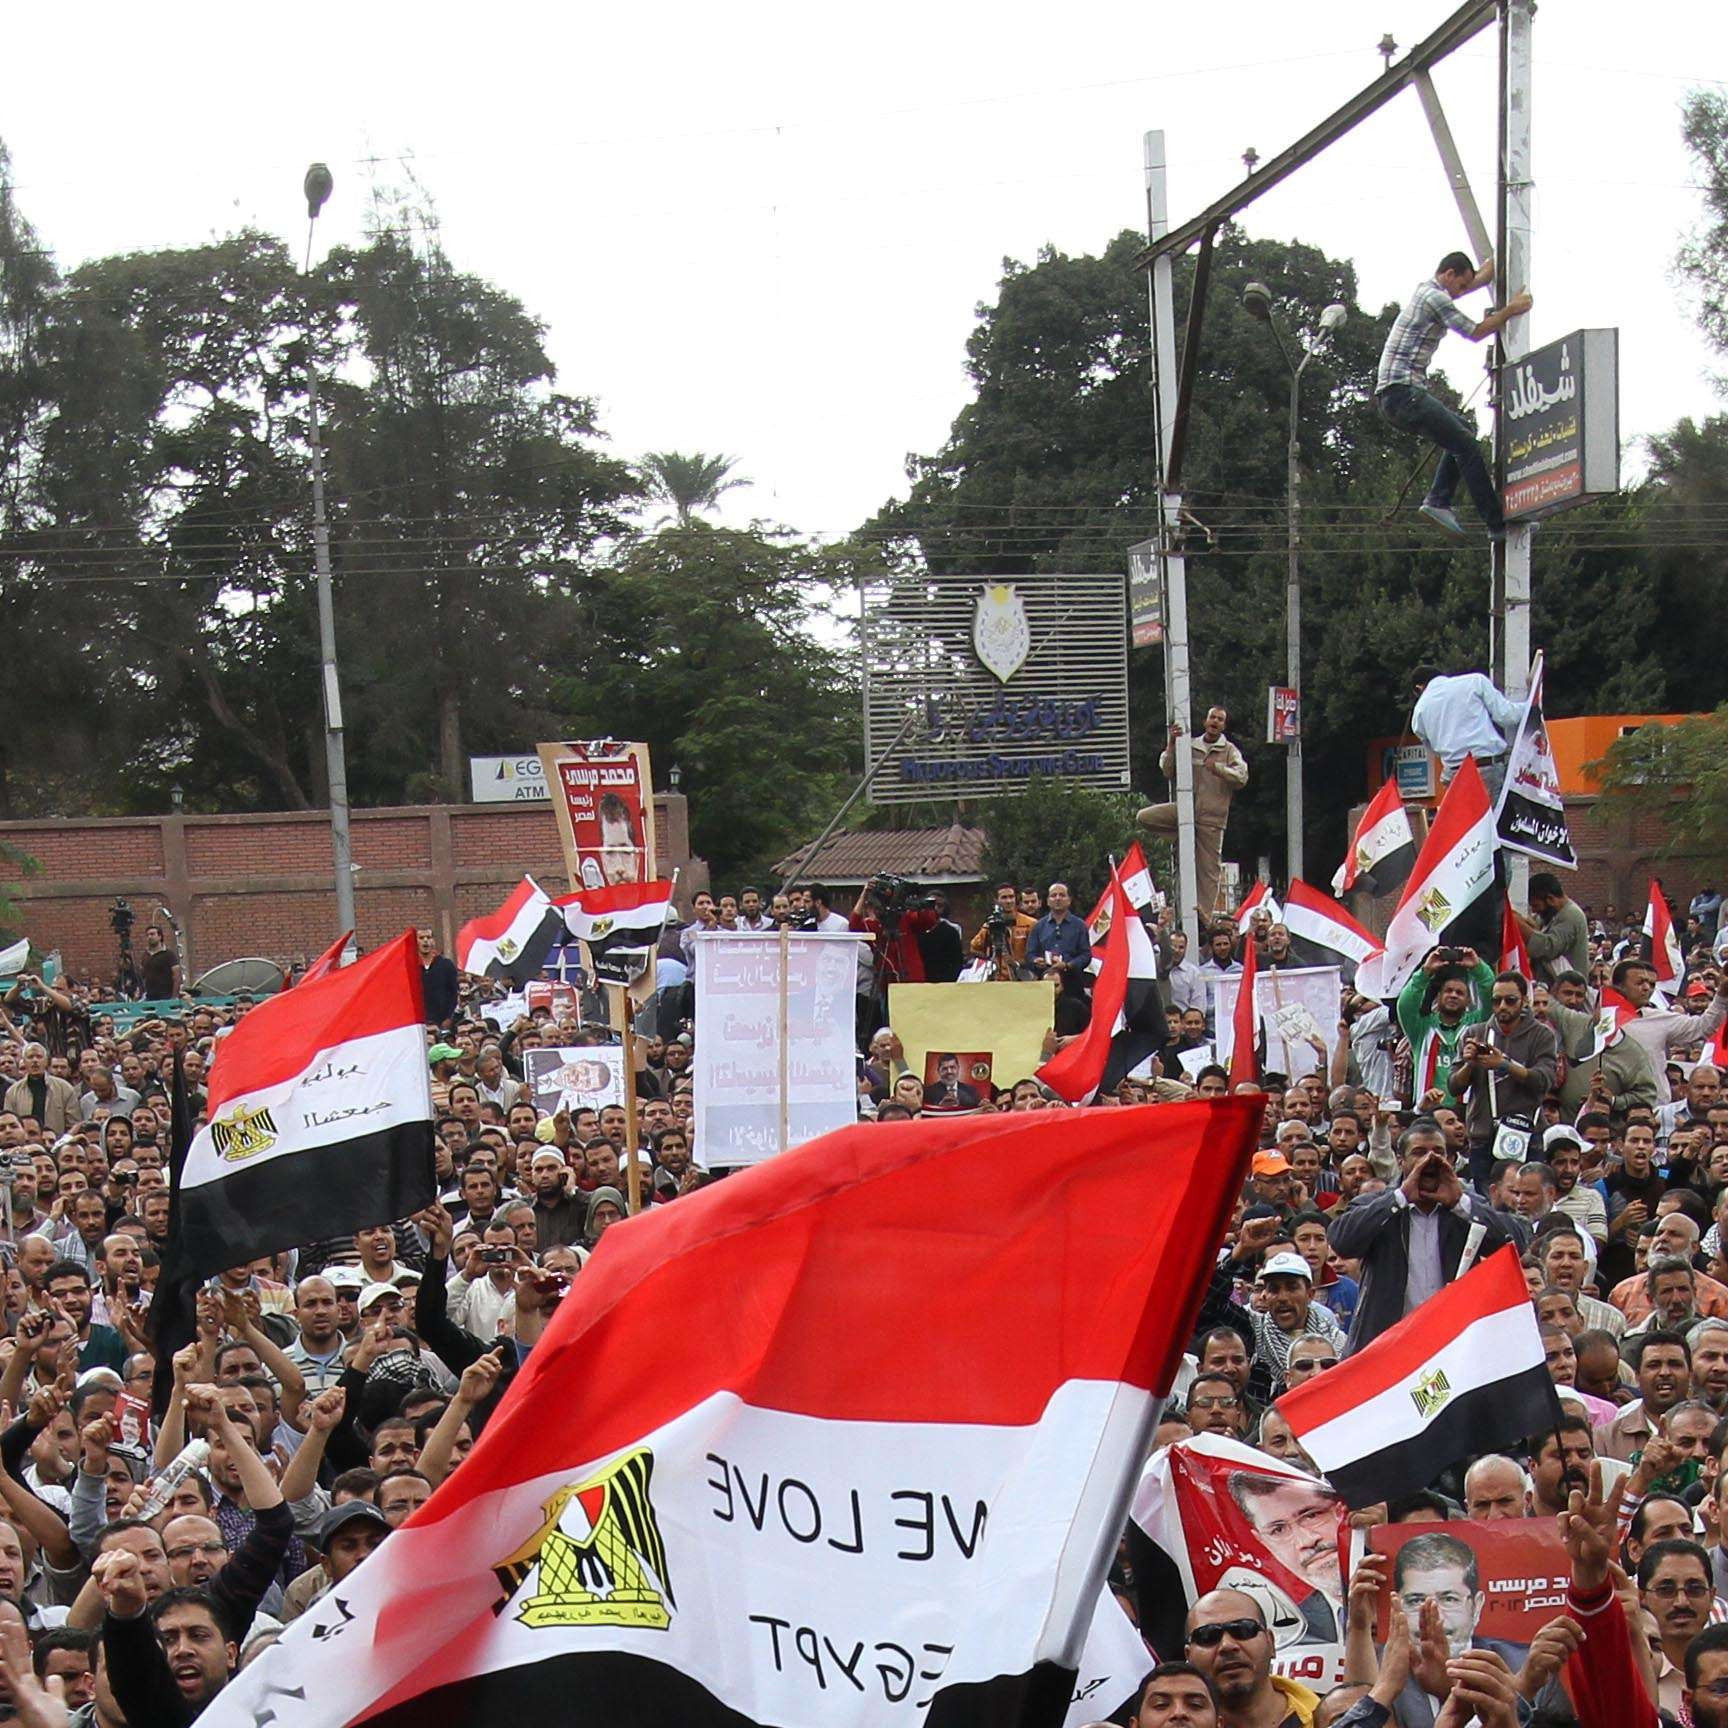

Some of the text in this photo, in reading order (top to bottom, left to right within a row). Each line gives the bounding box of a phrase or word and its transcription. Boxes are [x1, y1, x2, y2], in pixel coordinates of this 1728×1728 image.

[516, 760, 544, 775] EG
[601, 768, 635, 785] محمد
[515, 787, 544, 798] ATM
[1522, 1593, 1566, 1612] لمصر
